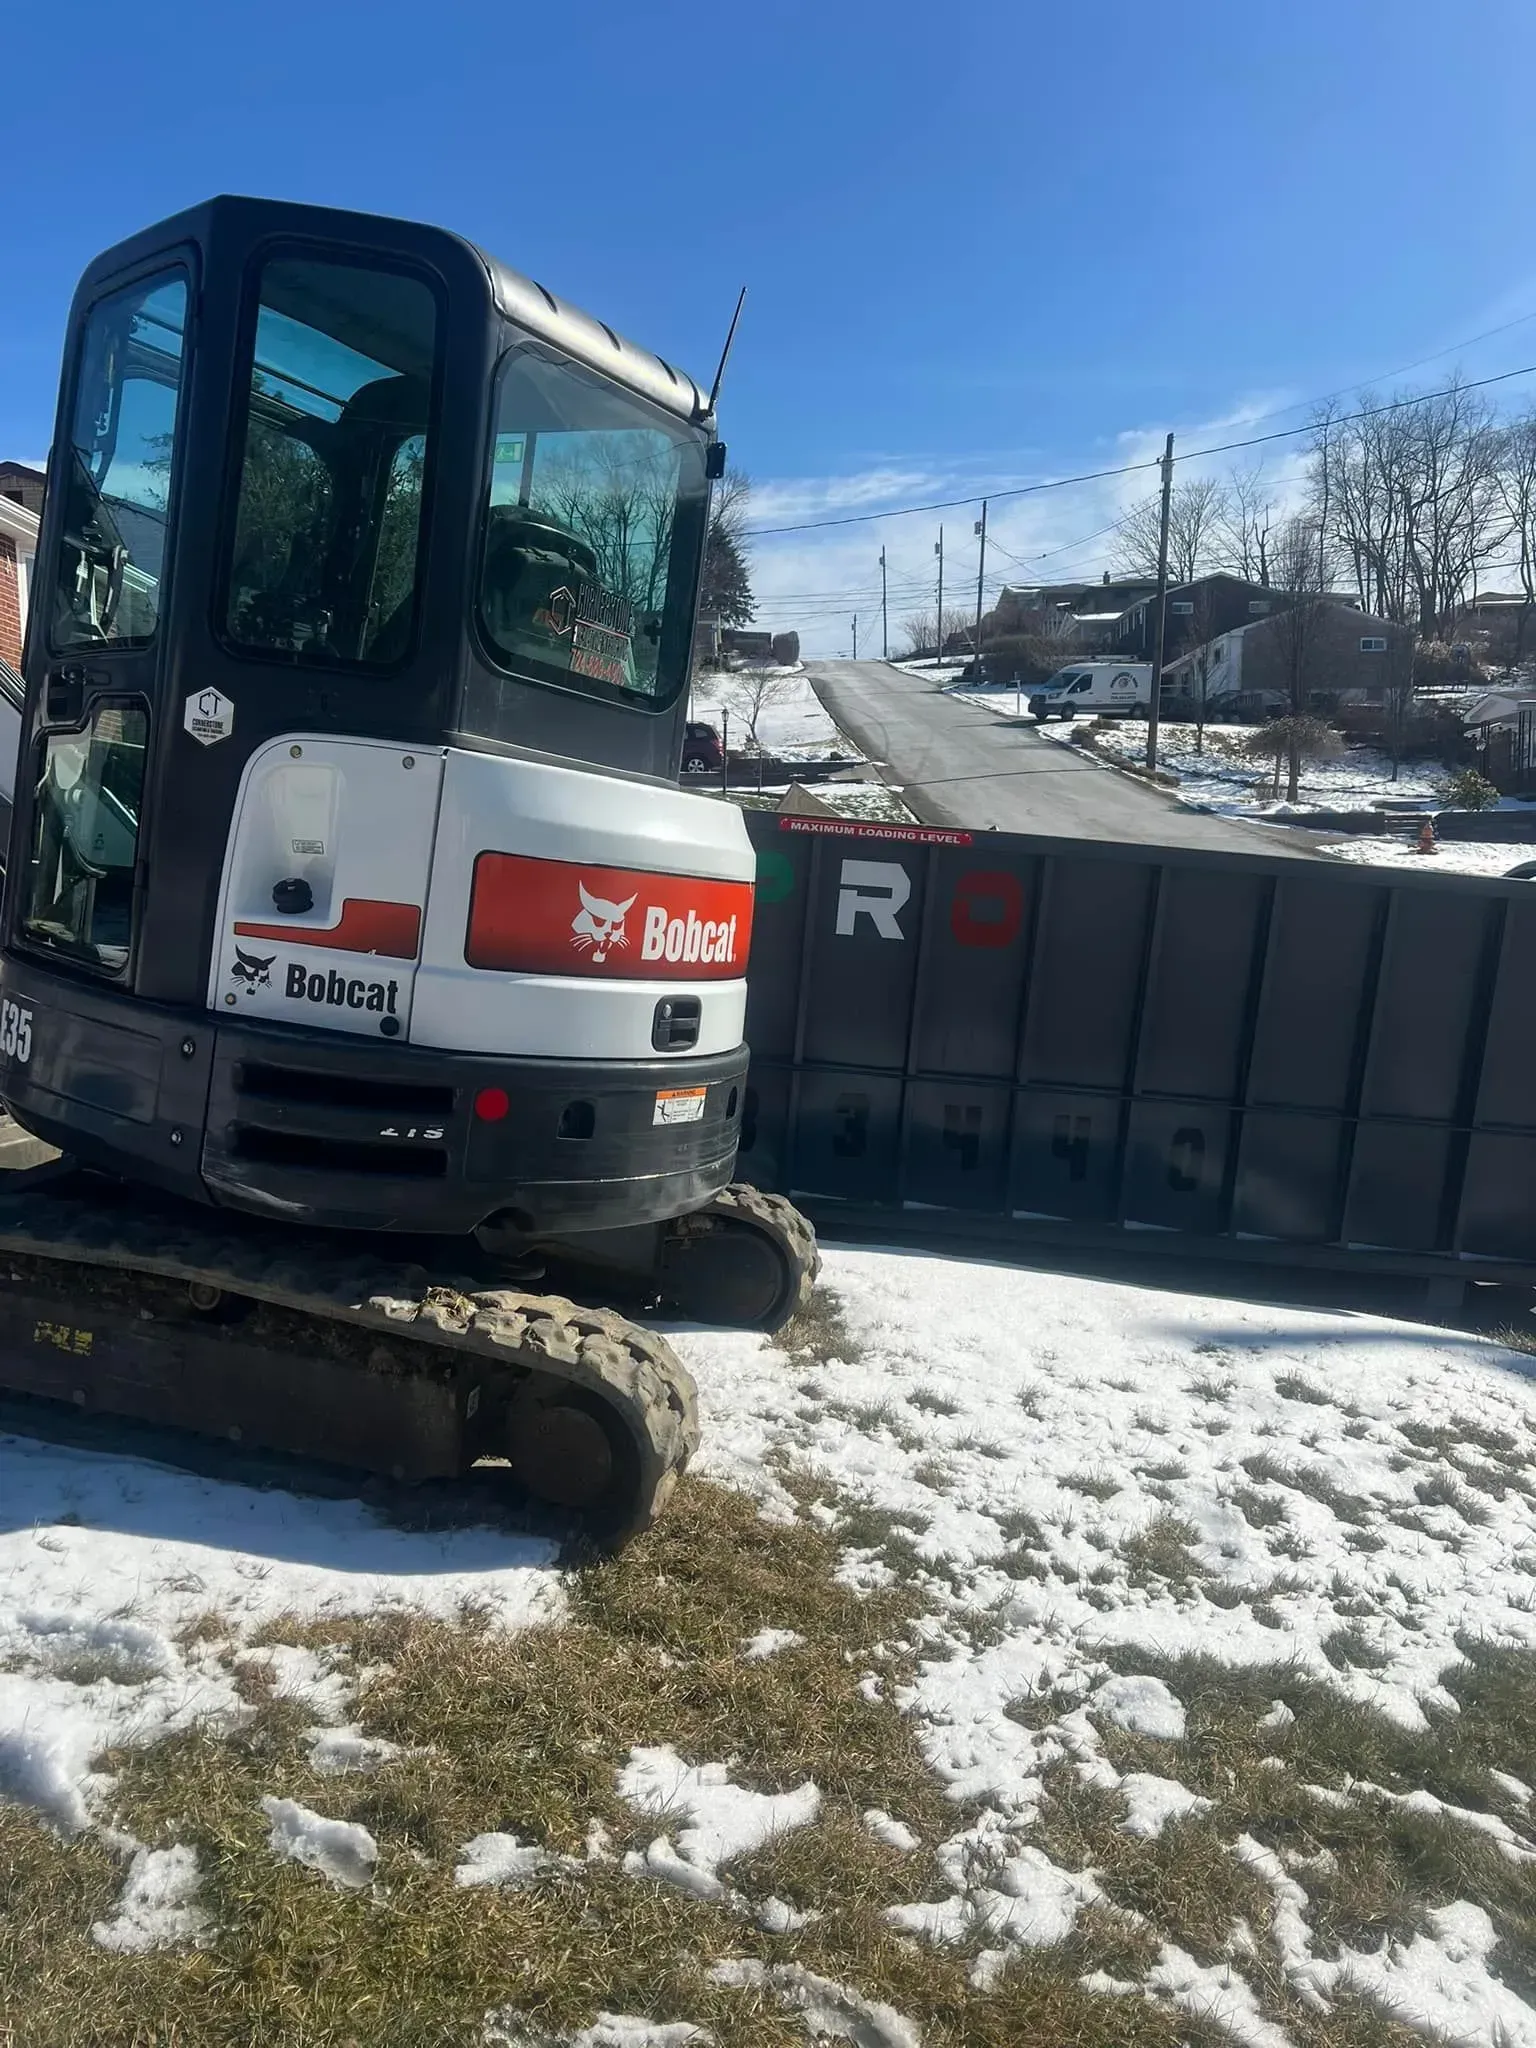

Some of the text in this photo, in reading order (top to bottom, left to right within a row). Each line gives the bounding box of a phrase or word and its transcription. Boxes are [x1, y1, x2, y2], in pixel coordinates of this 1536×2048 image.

[790, 822, 961, 844] MAXIMUM LOADING LEVEL
[641, 906, 736, 963] Bobcat
[285, 963, 399, 1014] Bobcat
